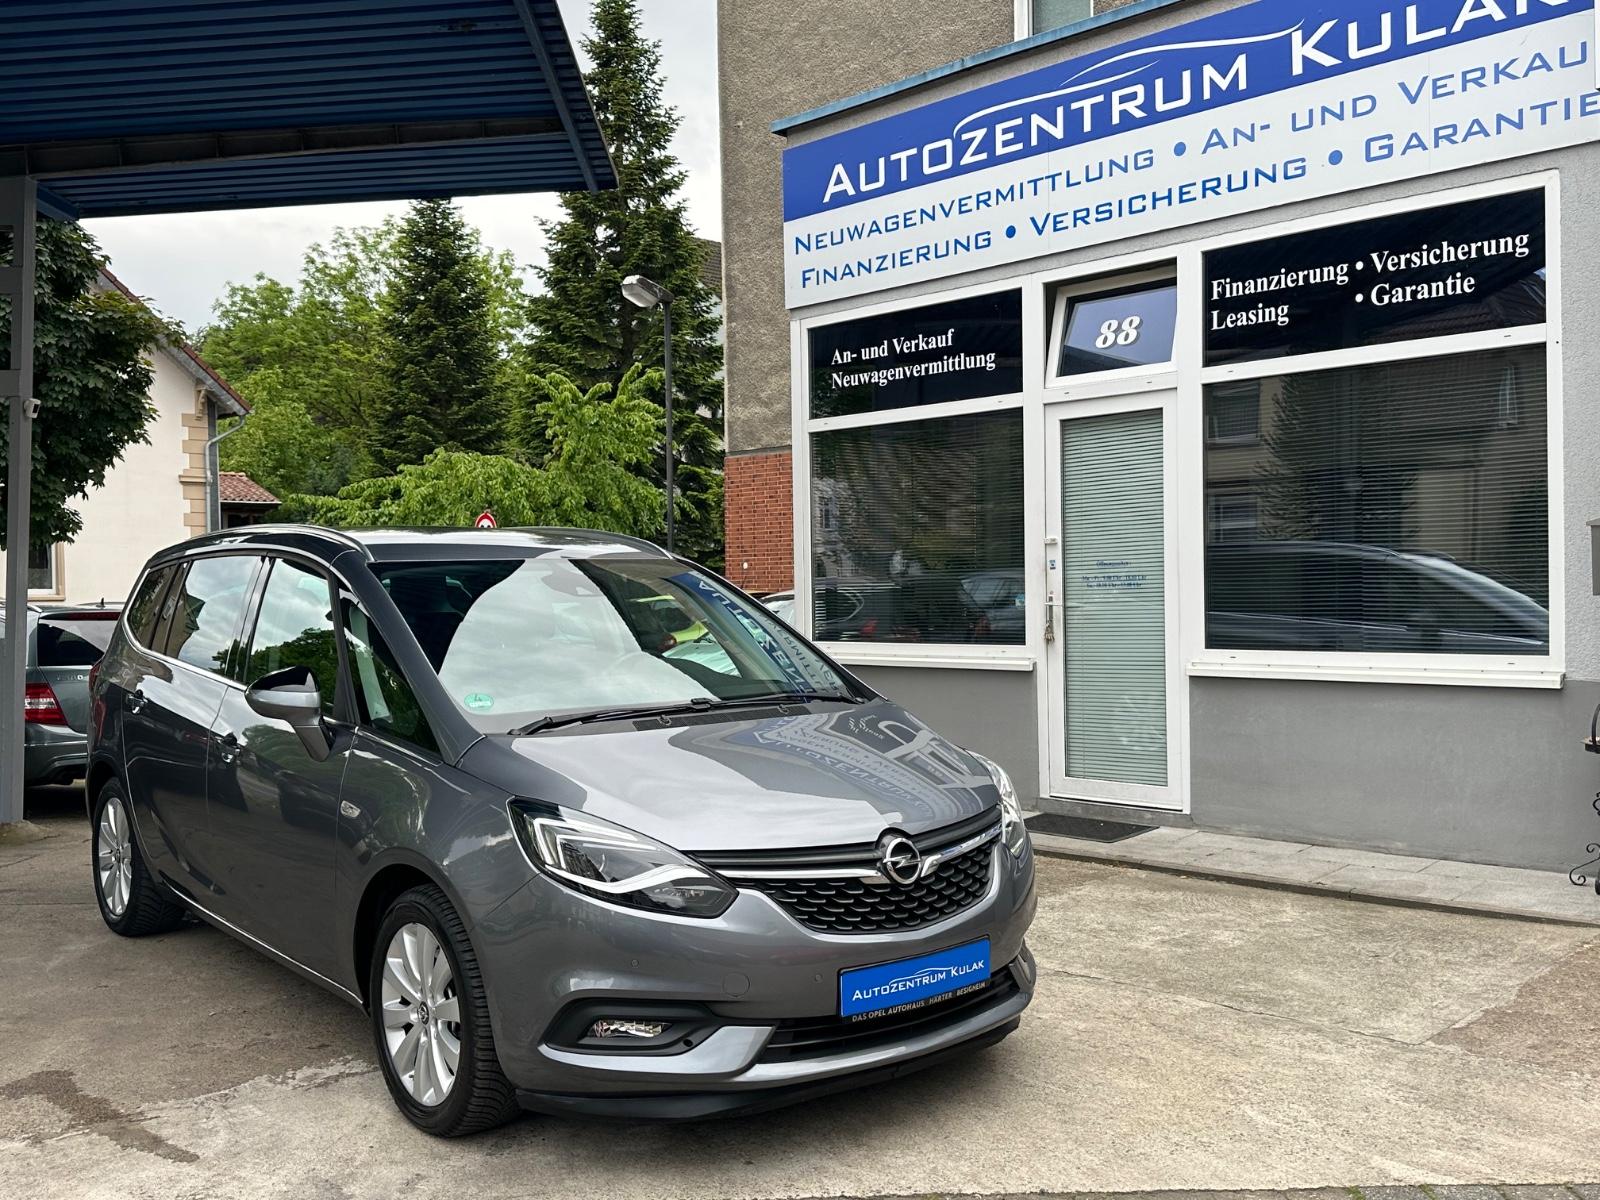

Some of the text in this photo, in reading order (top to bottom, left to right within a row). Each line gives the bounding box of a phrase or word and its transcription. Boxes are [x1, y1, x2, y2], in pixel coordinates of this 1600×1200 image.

[822, 53, 1248, 204] AUTOZENTRUM
[794, 148, 1155, 256] NEUWAGENVERMITTLUNG
[1201, 122, 1272, 155] AN-
[1290, 93, 1377, 133] UND
[801, 91, 1600, 289] FINANZIERUNG VERSICHERUNG GARANTIE
[1211, 233, 1530, 301] Finanzierung Versicherung
[1211, 272, 1476, 331] Leasing Garantie
[831, 328, 955, 366] An- und Verkauf
[1095, 315, 1142, 349] 88
[831, 352, 997, 389] Neuwagenvermittlung
[852, 959, 985, 1001] AUTOZENTRUM KULAK
[852, 1012, 867, 1022] DAS
[868, 1008, 886, 1019] OPEL
[887, 1001, 925, 1015] AUTOHAUS
